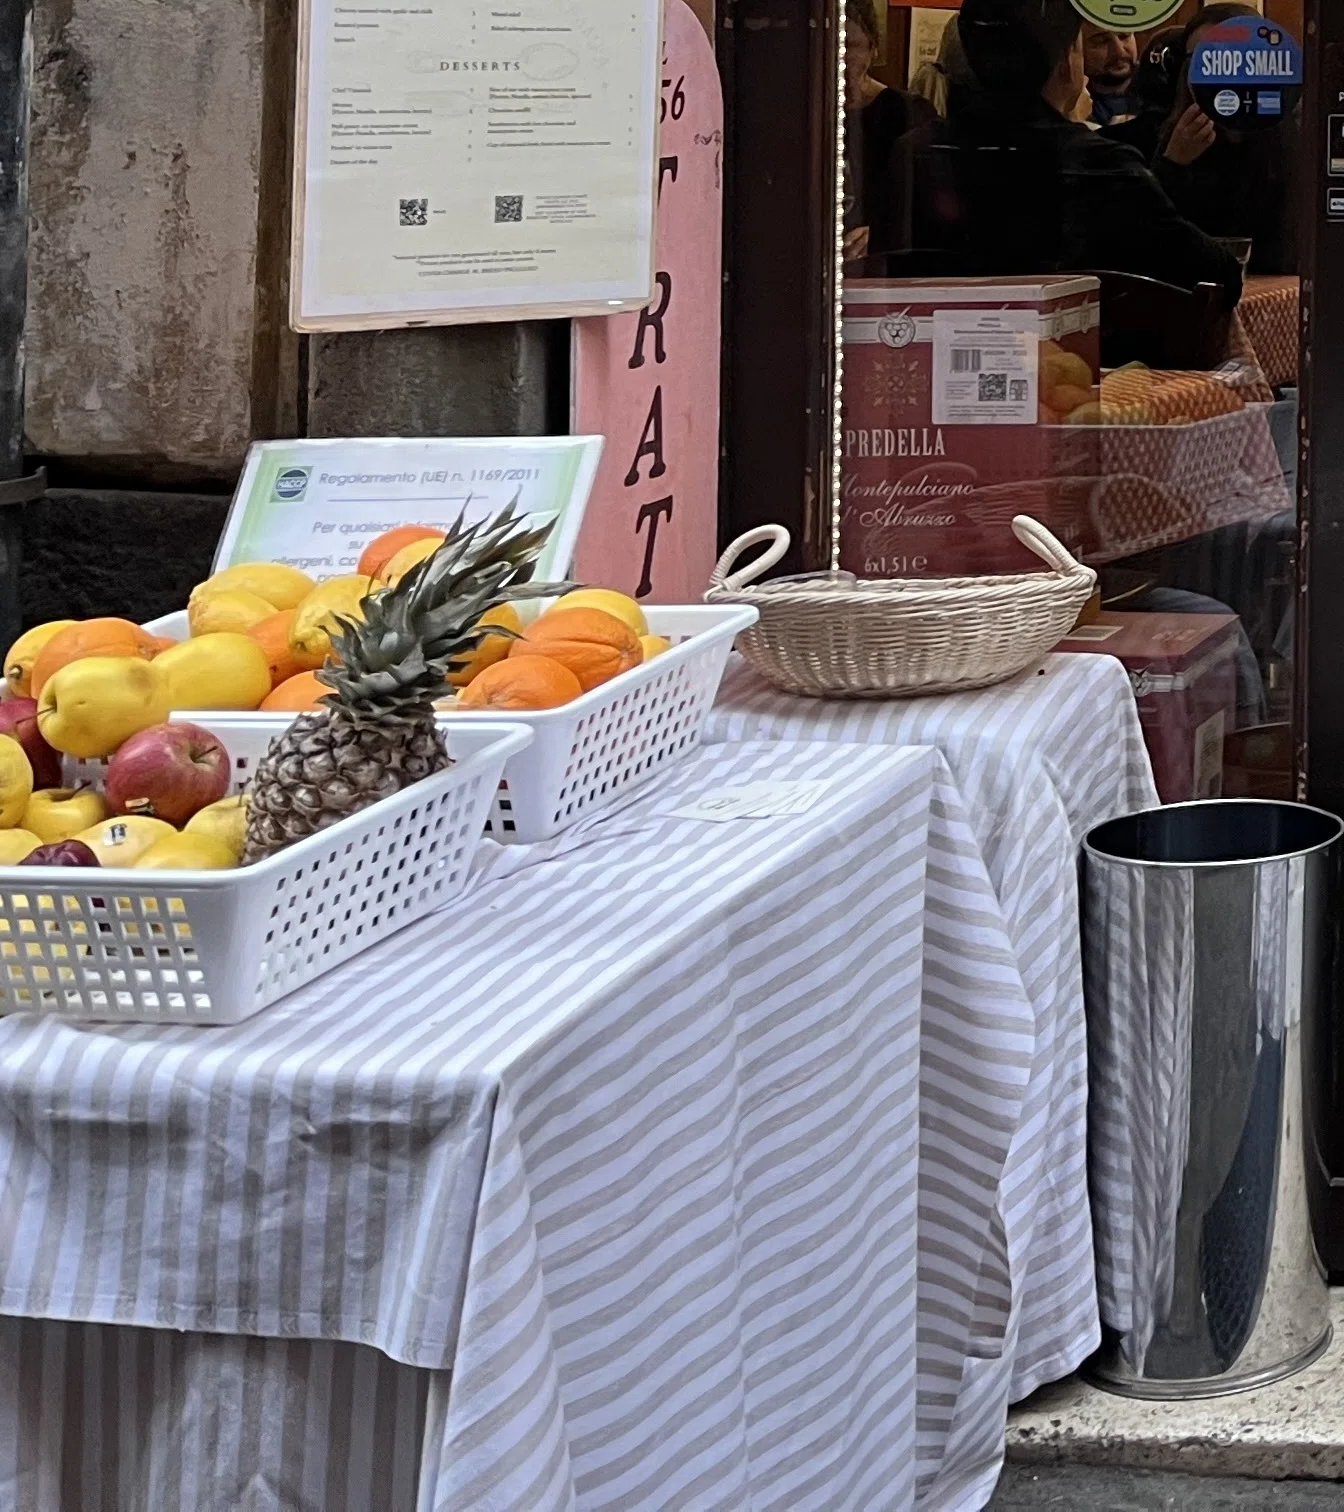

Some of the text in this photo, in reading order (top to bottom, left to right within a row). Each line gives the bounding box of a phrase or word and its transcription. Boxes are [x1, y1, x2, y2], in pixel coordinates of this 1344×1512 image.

[439, 60, 522, 73] DESSERTS
[1201, 50, 1294, 76] SHOP SMALL
[846, 427, 947, 457] PREDELLA
[318, 471, 417, 487] Regolamento
[471, 467, 540, 483] 1169/2011
[312, 521, 338, 533] Per
